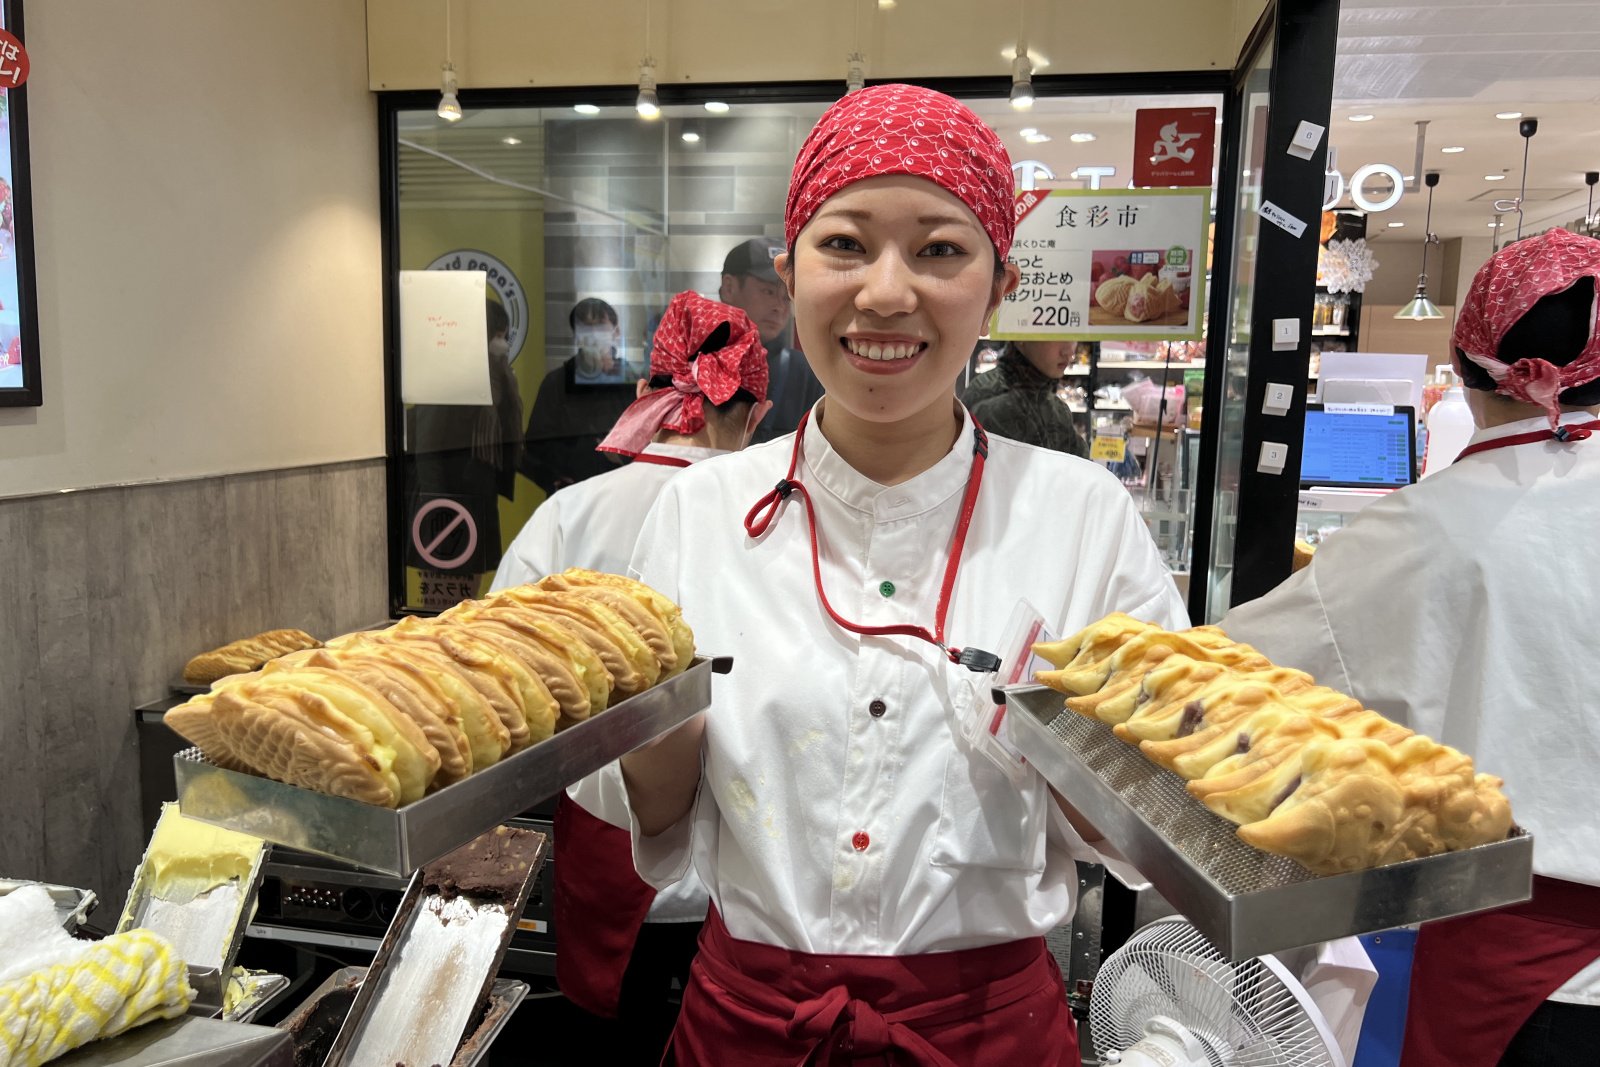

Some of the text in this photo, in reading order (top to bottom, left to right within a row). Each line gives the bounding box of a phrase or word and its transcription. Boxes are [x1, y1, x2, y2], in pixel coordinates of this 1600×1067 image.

[0, 40, 19, 61] は
[1014, 192, 1038, 222] の品
[1055, 204, 1139, 228] 食彩市
[1011, 240, 1056, 249] 浜くりこ庵
[1020, 271, 1073, 285] ちおとめ
[1276, 392, 1283, 400] 2
[1270, 451, 1277, 459] 3
